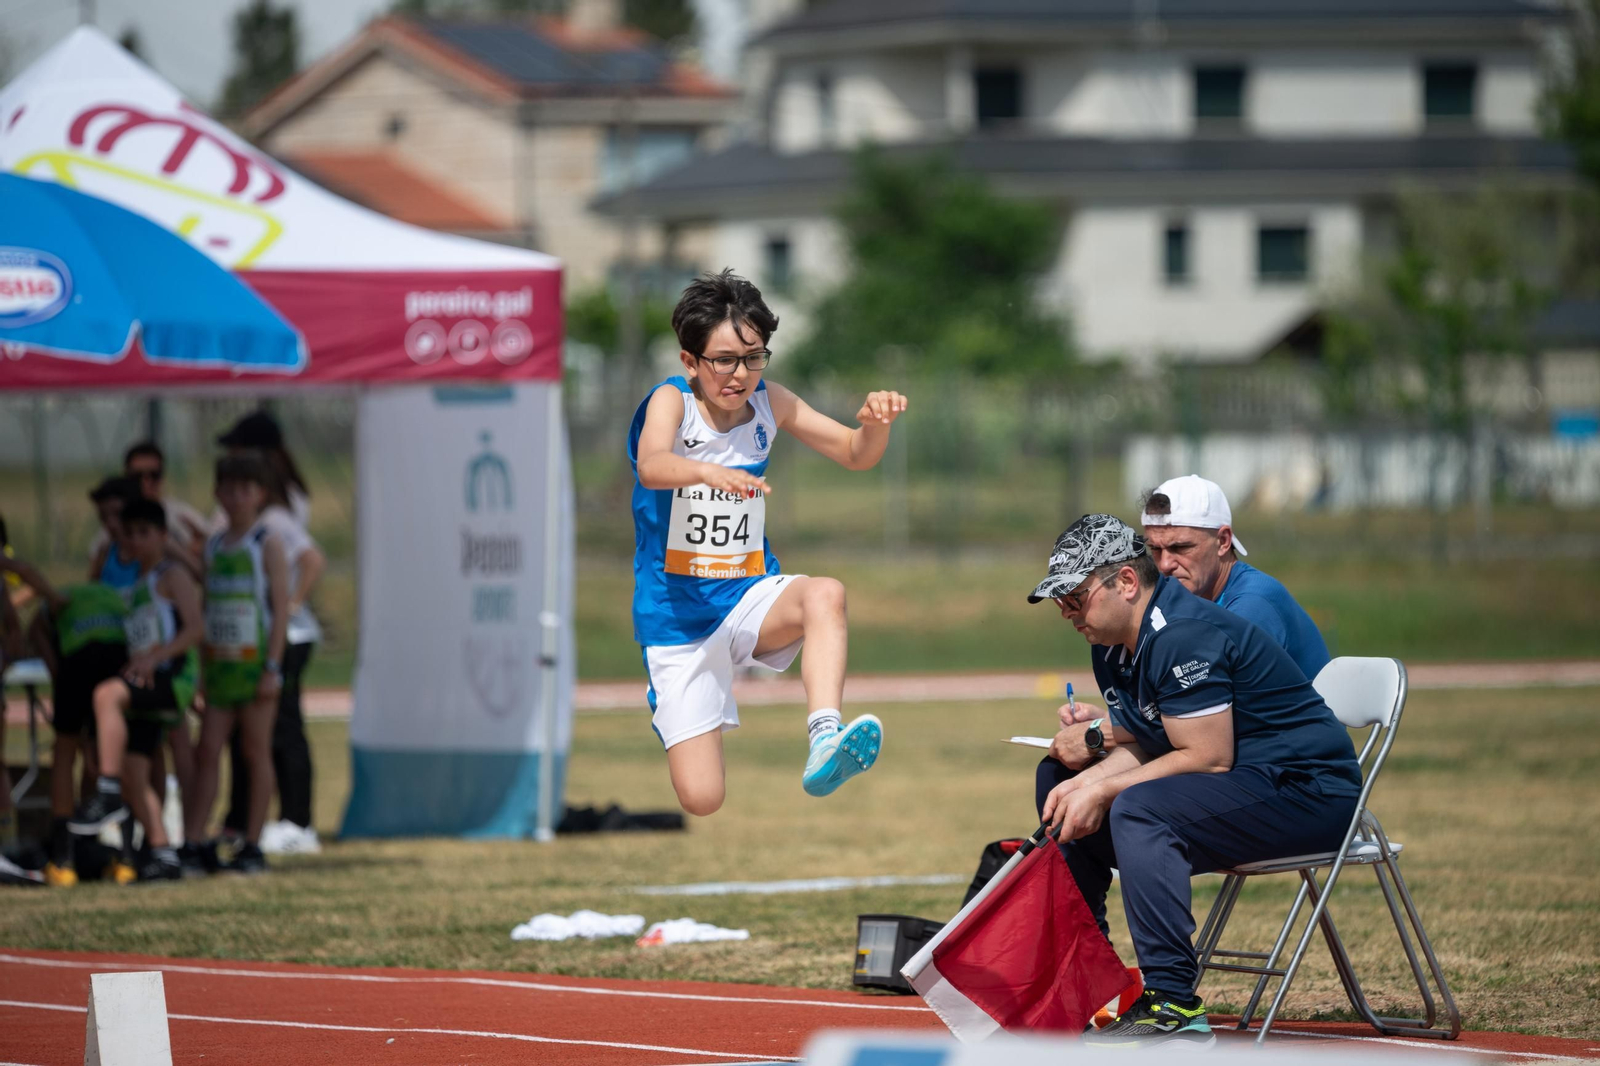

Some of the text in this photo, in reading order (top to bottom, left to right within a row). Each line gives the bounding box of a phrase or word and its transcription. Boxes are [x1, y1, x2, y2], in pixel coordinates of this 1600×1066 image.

[404, 286, 532, 323] pereiro.gal
[676, 487, 762, 505] La Regón
[685, 513, 750, 547] 354
[689, 565, 747, 578] telemiño
[1181, 660, 1199, 670] XUNTA
[1190, 661, 1210, 672] GALICIA
